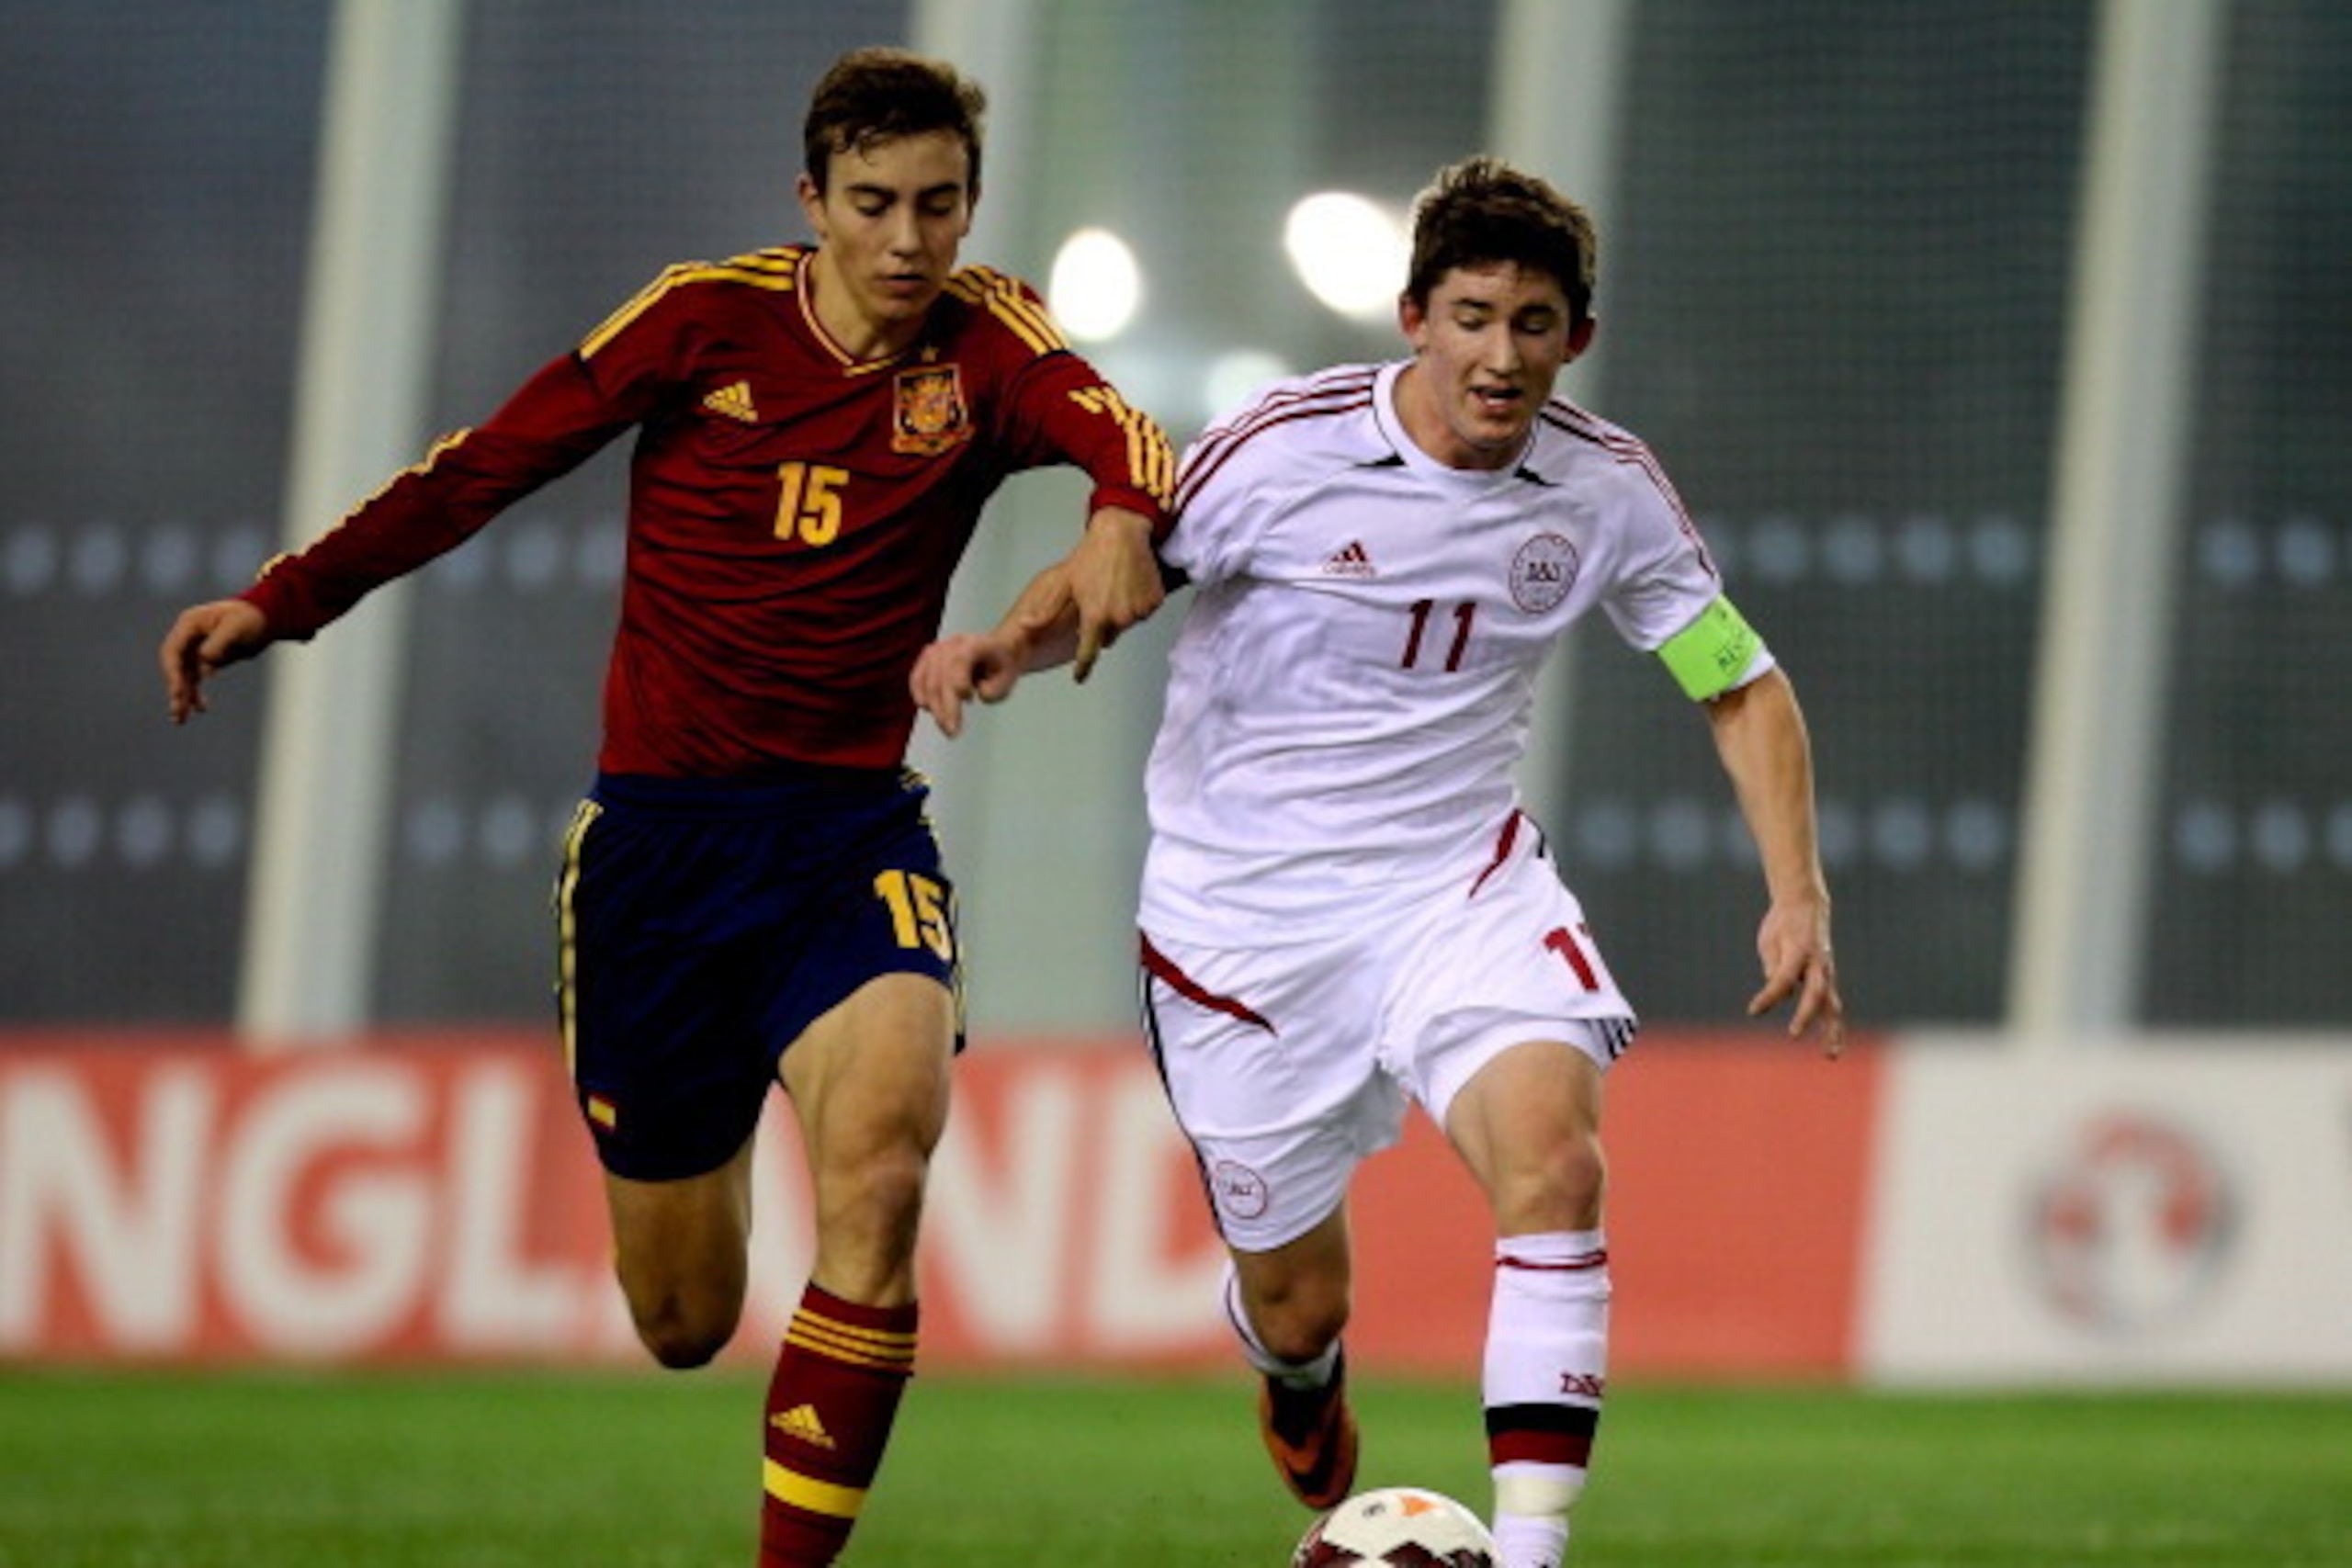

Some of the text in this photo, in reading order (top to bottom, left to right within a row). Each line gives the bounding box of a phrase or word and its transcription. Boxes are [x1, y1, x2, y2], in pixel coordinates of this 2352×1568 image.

[774, 462, 850, 546] 15
[1400, 599, 1476, 672] 11
[873, 869, 953, 962] 15
[1543, 922, 1600, 993] 1
